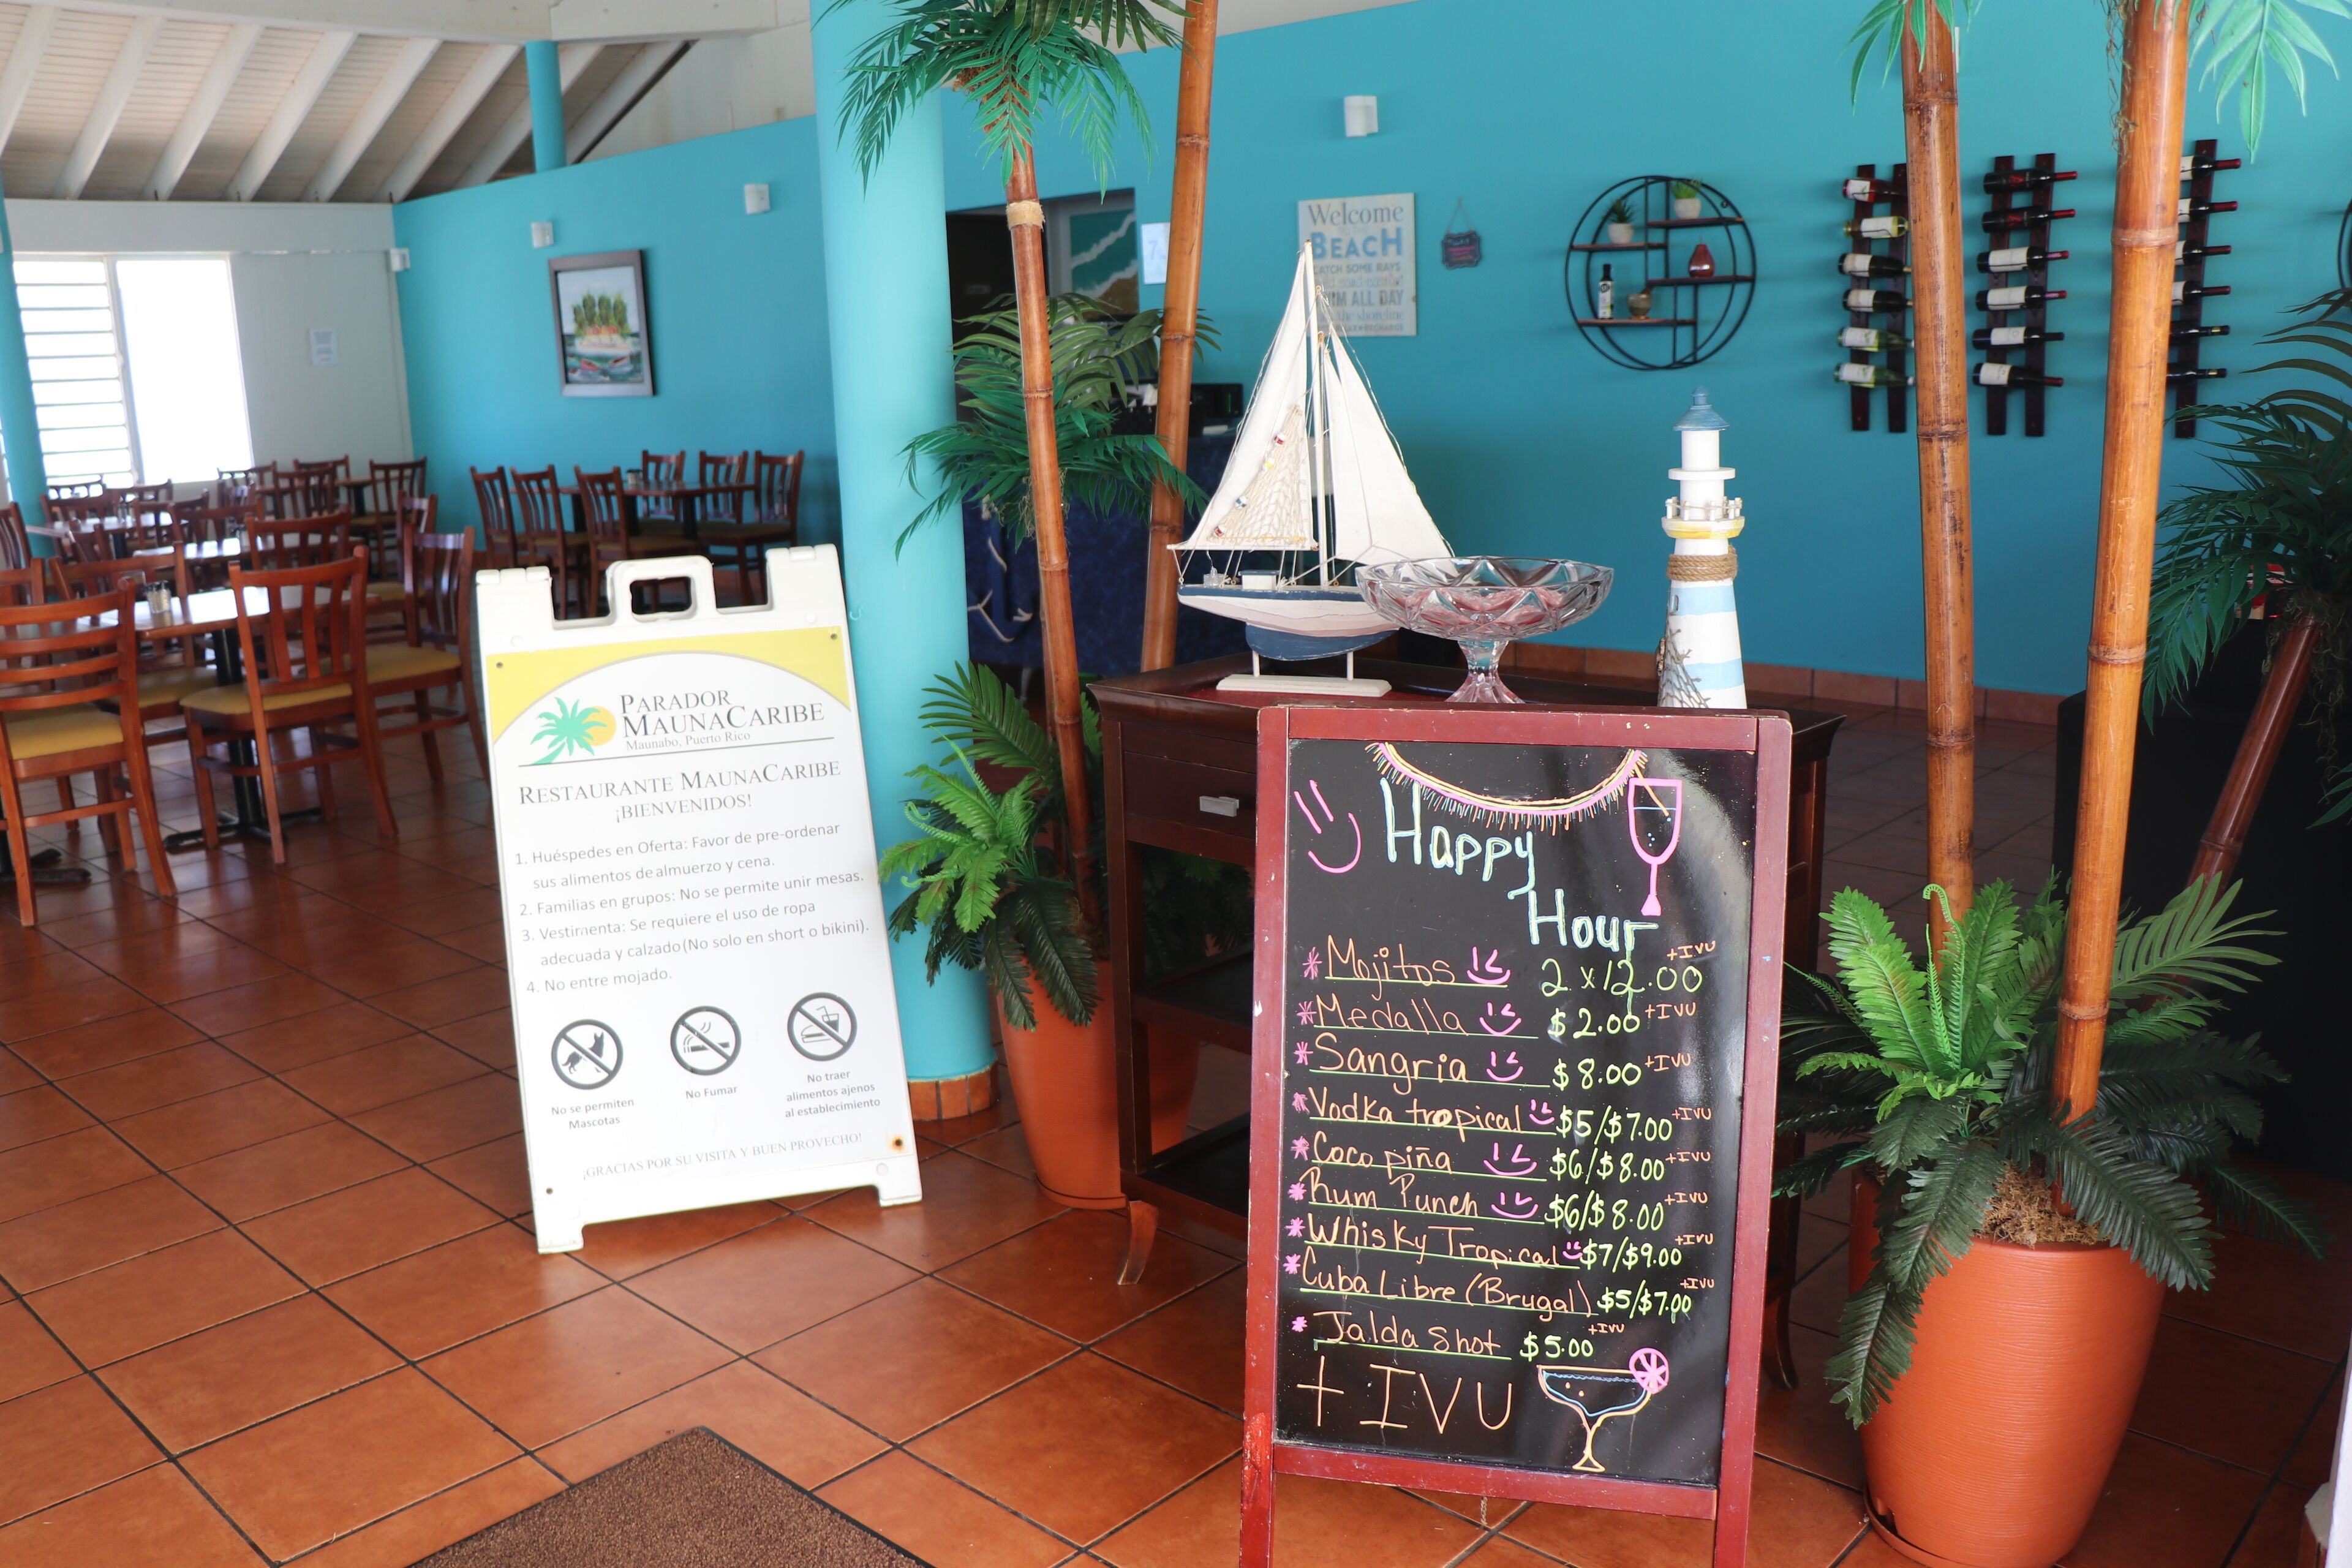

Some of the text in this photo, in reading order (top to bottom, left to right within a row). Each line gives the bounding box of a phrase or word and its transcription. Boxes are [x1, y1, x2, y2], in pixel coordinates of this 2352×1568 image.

[1307, 202, 1404, 226] Welcome
[1311, 227, 1403, 260] BEACH
[1346, 263, 1373, 273] SOME
[1376, 261, 1402, 271] RAYS
[1352, 290, 1374, 306] ALL
[1379, 288, 1404, 306] DAY
[620, 690, 731, 714] PARADOR
[625, 731, 751, 751] Maunabo, Puerto Rico
[519, 777, 674, 805] RESTAURANTE
[616, 794, 752, 823] ¡BIENVENIDOS!
[515, 823, 840, 865] 1. Huéspedes en Oferta: Favor de pre-ordenar
[1380, 777, 1536, 899] Happy
[533, 855, 775, 889] sus alimentos de almuerzo y cena.
[519, 870, 864, 916] 2. Familias en grupos: No se permite unir mesas.
[522, 901, 816, 942] 3. Vestimenta: Se requiere el uso de ropa
[1529, 889, 1658, 952] Hour
[540, 948, 611, 966] adecuada
[615, 948, 624, 962] y
[712, 934, 742, 949] solo
[746, 933, 764, 945] en
[768, 927, 805, 943] short
[808, 928, 818, 938] o
[822, 918, 870, 936] bikini).
[527, 969, 673, 993] 4. No entre mojado.
[1325, 934, 1456, 1000] Mojitos
[1542, 958, 1569, 998] 2
[1603, 959, 1703, 995] 12.00
[1315, 993, 1469, 1037] Medalla
[807, 1070, 851, 1084] No traer
[1314, 1032, 1470, 1095] Sangria
[551, 1098, 635, 1116] No se permiten
[685, 1085, 738, 1099] No Fumar
[785, 1098, 881, 1118] al establecimiento
[786, 1084, 875, 1102] alimentos ajenos
[568, 1115, 620, 1130] Mascotas
[1308, 1086, 1396, 1123] Vodka
[1405, 1098, 1523, 1143] tropical
[583, 1133, 862, 1180] ¡GRACIAS POR SU VISITA Y BUEN PROVECHO!
[1313, 1131, 1373, 1168] Coco
[1384, 1145, 1453, 1180] piña
[1299, 1166, 1381, 1211] Rum
[1389, 1172, 1479, 1217] Punch
[1308, 1212, 1427, 1265] Whisky
[1428, 1226, 1560, 1270] Tropical
[1302, 1245, 1370, 1294] Cuba
[1379, 1269, 1456, 1302] Libre
[1466, 1272, 1593, 1322] (Brugal)
[1428, 1326, 1501, 1355] Shot
